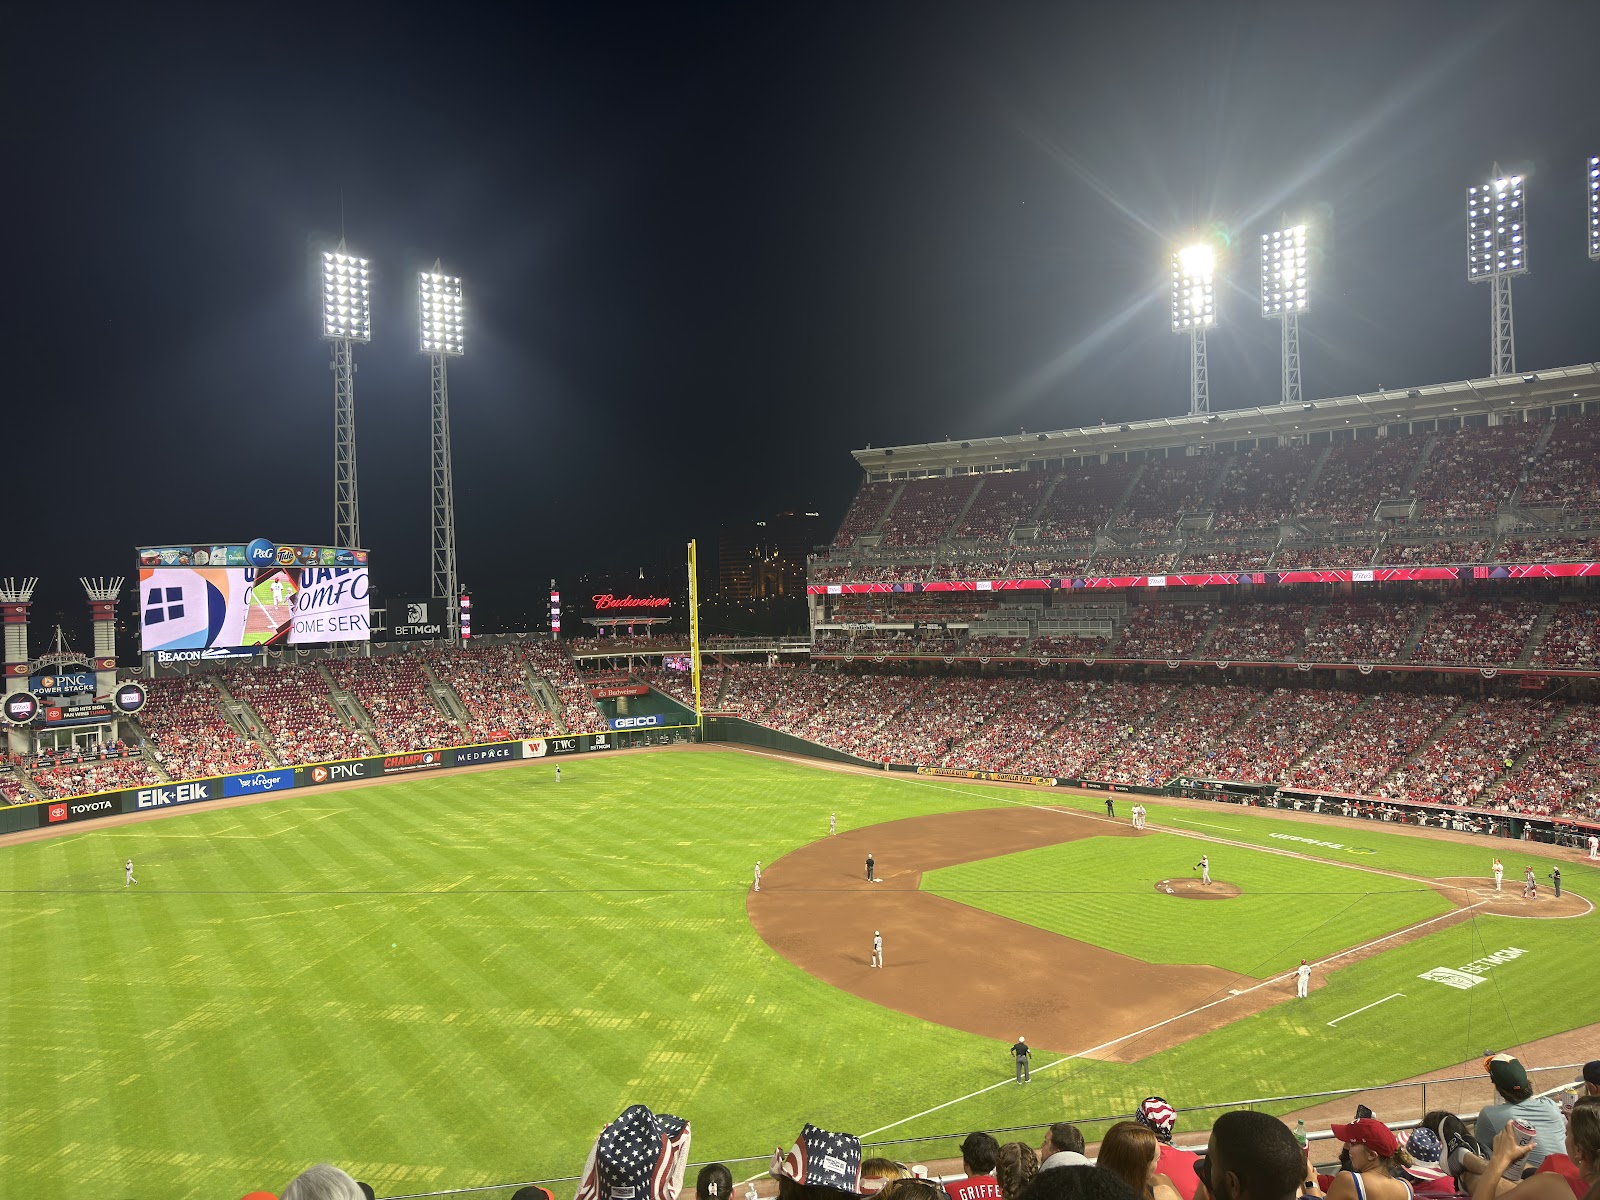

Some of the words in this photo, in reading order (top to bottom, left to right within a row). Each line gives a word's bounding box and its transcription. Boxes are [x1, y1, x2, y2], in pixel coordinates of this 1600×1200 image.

[253, 548, 274, 558] P&G
[277, 551, 294, 561] Tide
[592, 594, 670, 609] Budweiser
[395, 625, 441, 635] BETMGM
[158, 651, 200, 662] BEACON
[55, 675, 86, 686] PNC
[615, 716, 656, 728] GEICO
[528, 743, 541, 752] W
[552, 739, 576, 750] TWC
[457, 749, 510, 762] MEDPACE
[330, 763, 364, 779] PNC
[252, 774, 281, 789] Kroger
[71, 801, 112, 814] TOYOTA
[1458, 947, 1529, 974] BETMGM
